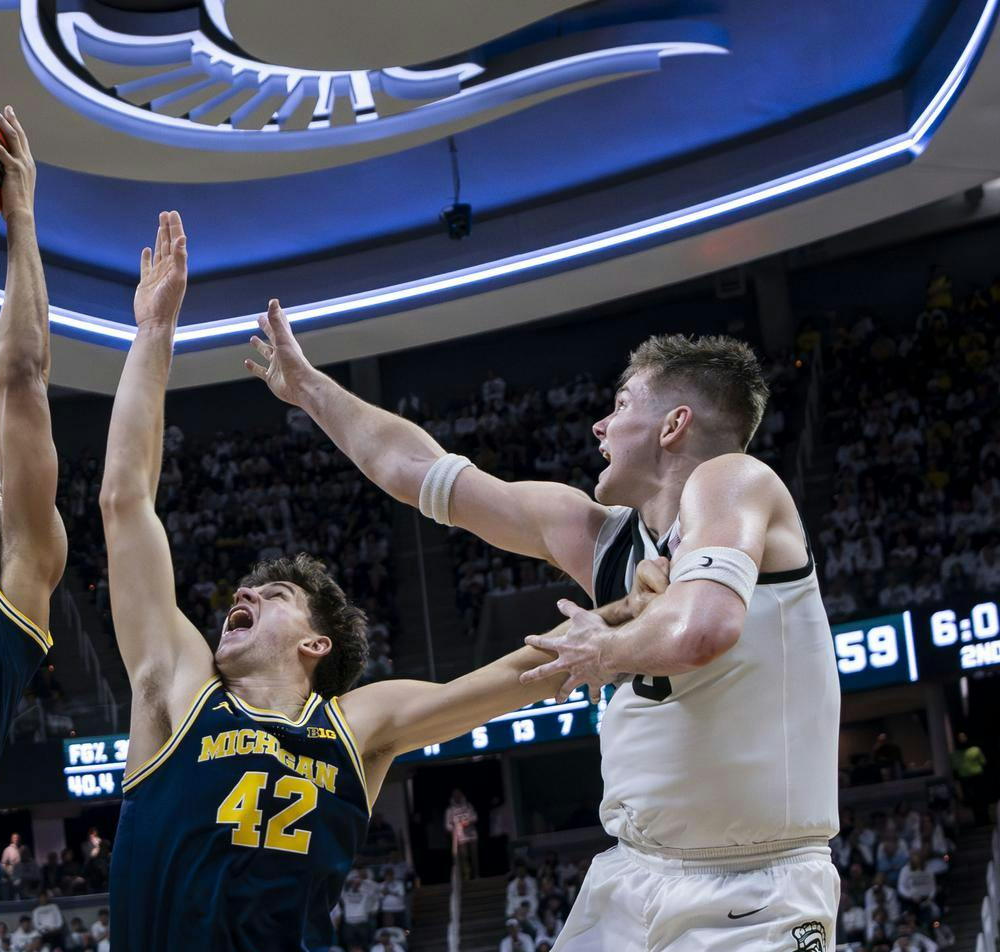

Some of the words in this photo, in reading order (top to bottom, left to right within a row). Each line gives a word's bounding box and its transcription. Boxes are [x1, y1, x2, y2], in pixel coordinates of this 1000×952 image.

[834, 624, 900, 674] 59
[471, 726, 489, 749] 5
[512, 719, 536, 743] 13
[558, 712, 574, 735] 7
[67, 772, 115, 796] 40.4
[216, 771, 318, 855] 42
